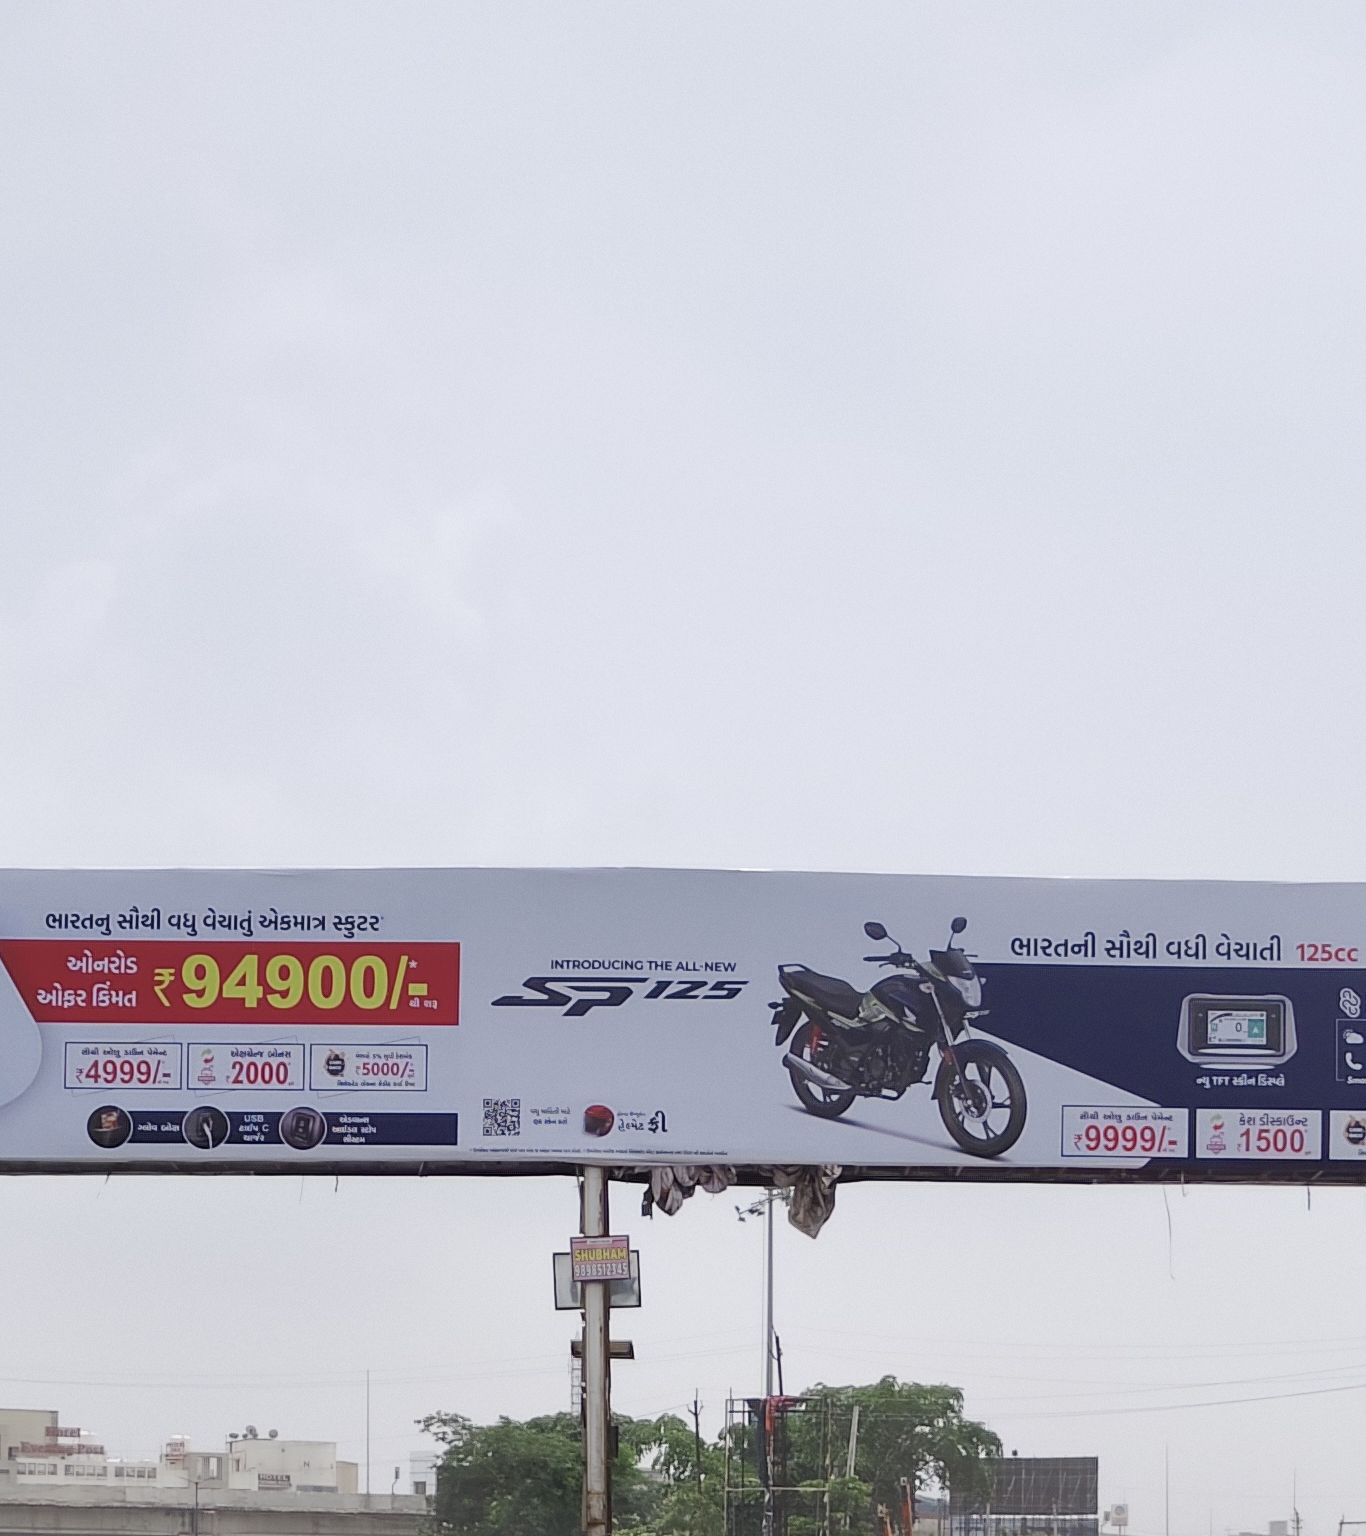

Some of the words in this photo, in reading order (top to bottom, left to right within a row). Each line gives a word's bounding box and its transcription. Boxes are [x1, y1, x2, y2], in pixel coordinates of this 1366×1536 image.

[117, 906, 161, 930] સૌથી
[168, 913, 198, 937] વધુ
[203, 907, 254, 938] વેચાતું
[258, 908, 326, 932] એકમાત્ર
[1010, 931, 1096, 957] ભારતની
[1104, 930, 1157, 959] સૌથી
[1215, 933, 1282, 961] વેચાતી
[1296, 943, 1358, 962] 125cc
[66, 949, 138, 974] ઓનરોડ
[550, 959, 644, 971] INTRODUCING
[647, 960, 672, 971] THE
[675, 960, 737, 972] ALL-NEW
[36, 982, 87, 1008] ઓફર
[92, 981, 137, 1008] કિંમત
[491, 976, 650, 1017] SP
[644, 980, 750, 1000] 125
[244, 1114, 264, 1122] USB
[575, 1247, 628, 1261] SHUBHAM
[575, 1262, 628, 1277] 9898512345
